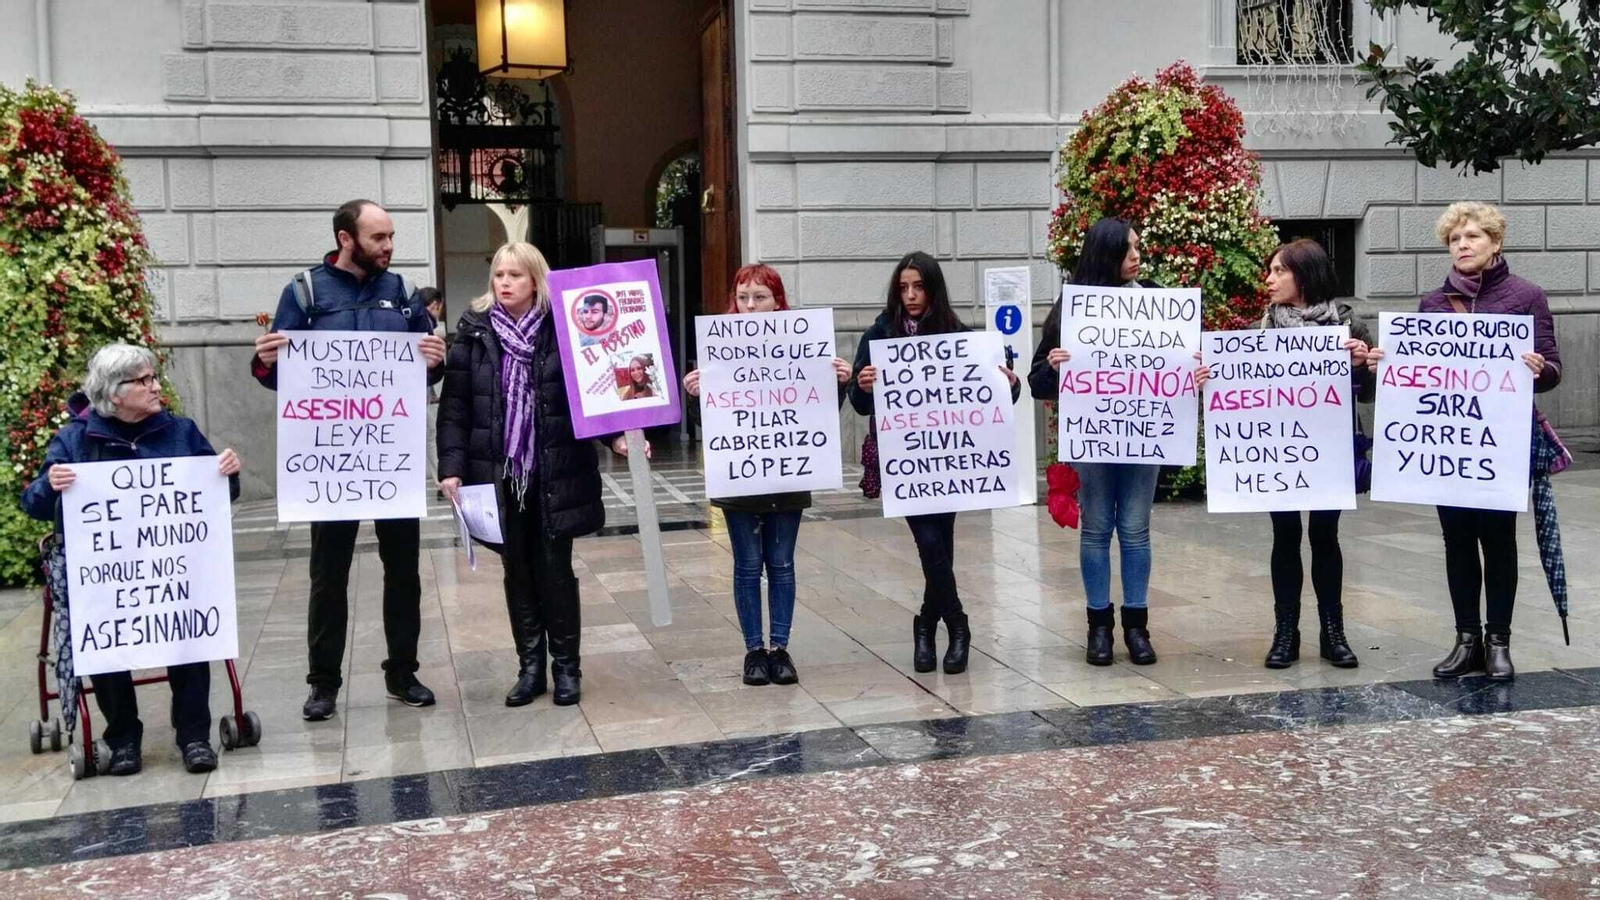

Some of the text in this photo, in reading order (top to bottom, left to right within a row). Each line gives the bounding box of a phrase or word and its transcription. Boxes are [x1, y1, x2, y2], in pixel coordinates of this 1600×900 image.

[1071, 294, 1196, 322] FERNANDO
[707, 317, 809, 338] ANTONIO
[1078, 325, 1186, 349] QUESADA
[1389, 316, 1529, 340] SERGIO RUBIO
[287, 337, 415, 363] MUSTAPHA
[706, 339, 832, 361] RODRÍGUEZ
[887, 339, 969, 363] JORGE
[1213, 330, 1345, 354] JOSÉ MANUEL
[1396, 341, 1514, 361] ARGONILLA
[580, 347, 600, 366] EL
[1091, 350, 1166, 370] PARDO
[310, 366, 394, 389] BRIACH
[733, 361, 806, 383] GARCÍA
[882, 364, 982, 387] LÓPEZ
[1207, 360, 1349, 381] GUIRADO CAMPOS
[1382, 363, 1516, 393] ASESINÓ A
[282, 393, 409, 420] ASESINÓ A
[705, 381, 820, 409] ASESINÓ A
[884, 385, 993, 410] ROMERO
[1209, 381, 1342, 412] ASESINÓ A
[1416, 393, 1483, 420] SARA
[732, 409, 799, 429] PILAR
[880, 406, 1004, 432] ASESINÓ A
[1095, 397, 1174, 419] JOSEFA
[314, 423, 395, 447] LEYRE
[1066, 416, 1175, 438] MARTINEZ
[1215, 420, 1309, 440] NURIA
[1384, 421, 1497, 447] CORREA
[709, 430, 827, 451] CABRERIZO
[904, 430, 976, 451] SILVIA
[1070, 439, 1165, 460] UTRILLA
[285, 450, 412, 473] GONZÁLEZ
[885, 450, 1011, 476] CONTRERAS
[1219, 445, 1319, 464] ALONSO
[1398, 450, 1496, 481] YUDES
[111, 462, 174, 489] QUE
[729, 454, 813, 480] LÓPEZ
[306, 479, 398, 504] JUSTO
[894, 475, 1006, 500] CARRANZA
[1235, 470, 1310, 494] MESA
[81, 491, 203, 523] SE PARE
[93, 521, 208, 552] EL MUNDO
[80, 555, 187, 586] PORQUE NOS
[116, 578, 190, 609] ESTÁN
[80, 606, 220, 653] ASESINANDO
